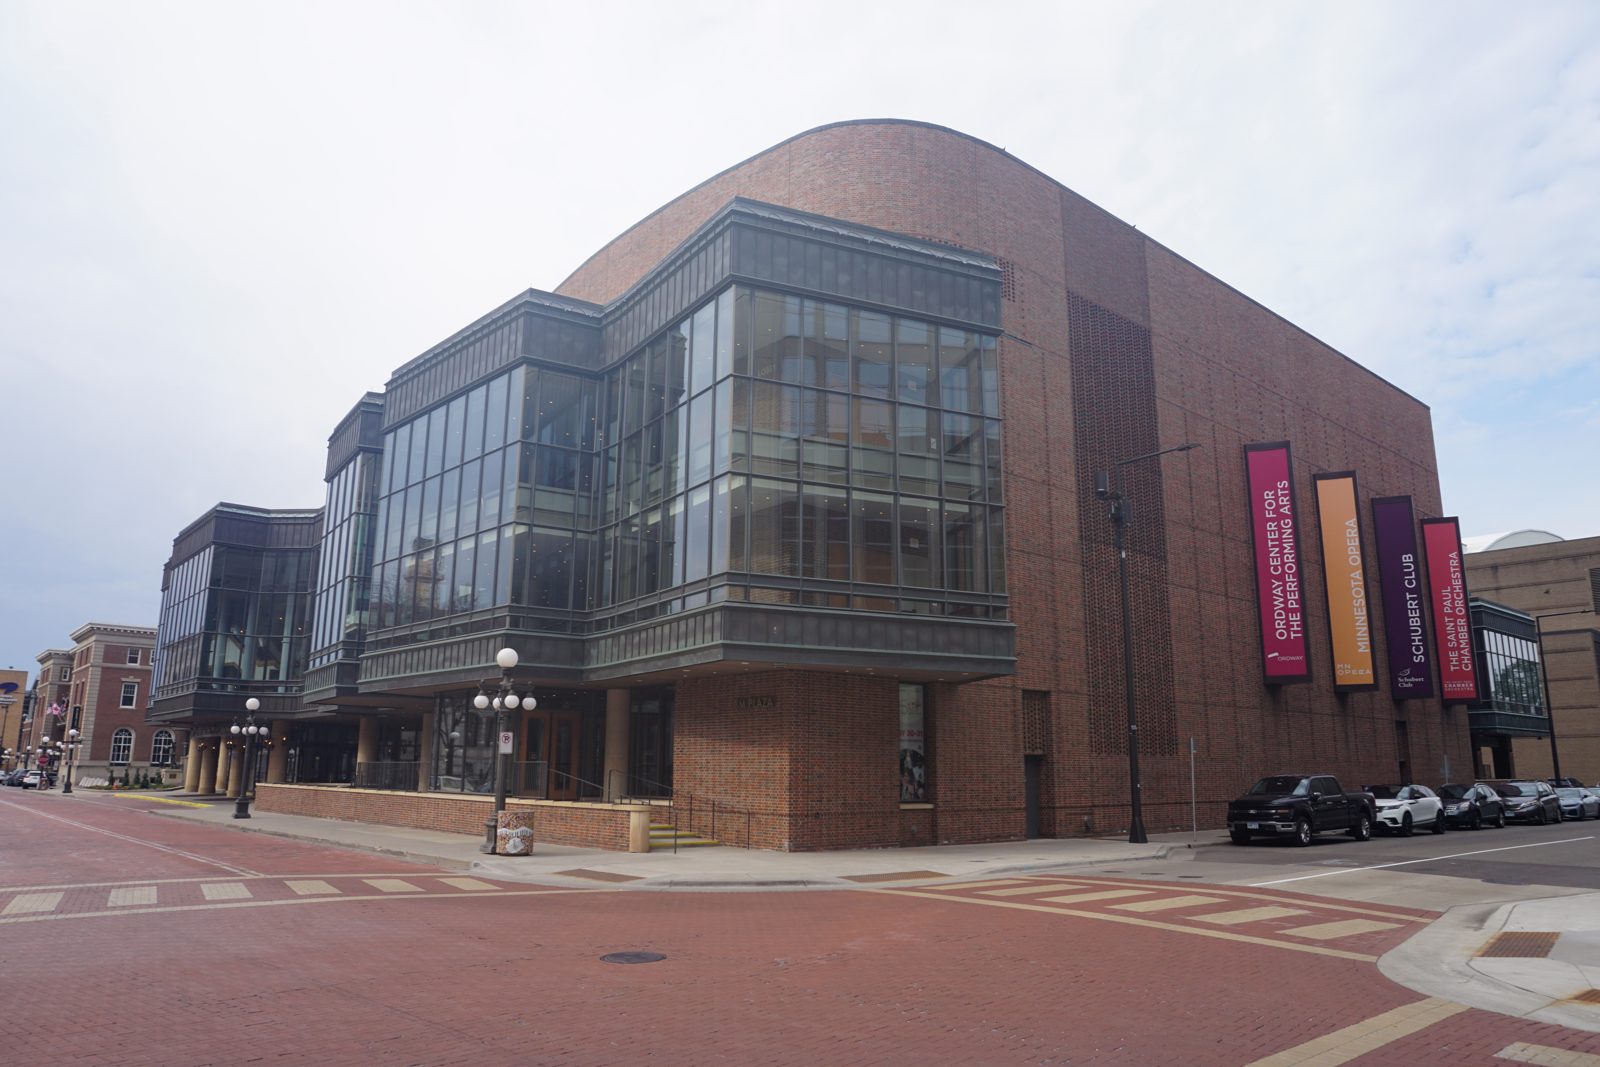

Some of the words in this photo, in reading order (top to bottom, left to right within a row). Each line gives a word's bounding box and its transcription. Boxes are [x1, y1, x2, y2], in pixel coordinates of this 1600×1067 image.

[1264, 490, 1276, 518] FOR
[1277, 480, 1292, 515] ARTS
[1267, 521, 1281, 576] CENTER
[1281, 518, 1299, 609] PERFORMING
[1344, 517, 1361, 566] OPERA
[1402, 553, 1416, 588] CLUB
[1449, 551, 1465, 615] ORCHESTRA
[1272, 579, 1288, 640] ORDWAY
[1350, 569, 1369, 653] MINNESOTA
[1441, 586, 1453, 613] PAUL
[1289, 612, 1303, 639] THE
[1406, 592, 1424, 663] SCHUBERT
[1445, 616, 1457, 647] SAINT
[1457, 618, 1472, 671] CHAMBER
[1449, 650, 1459, 671] THE
